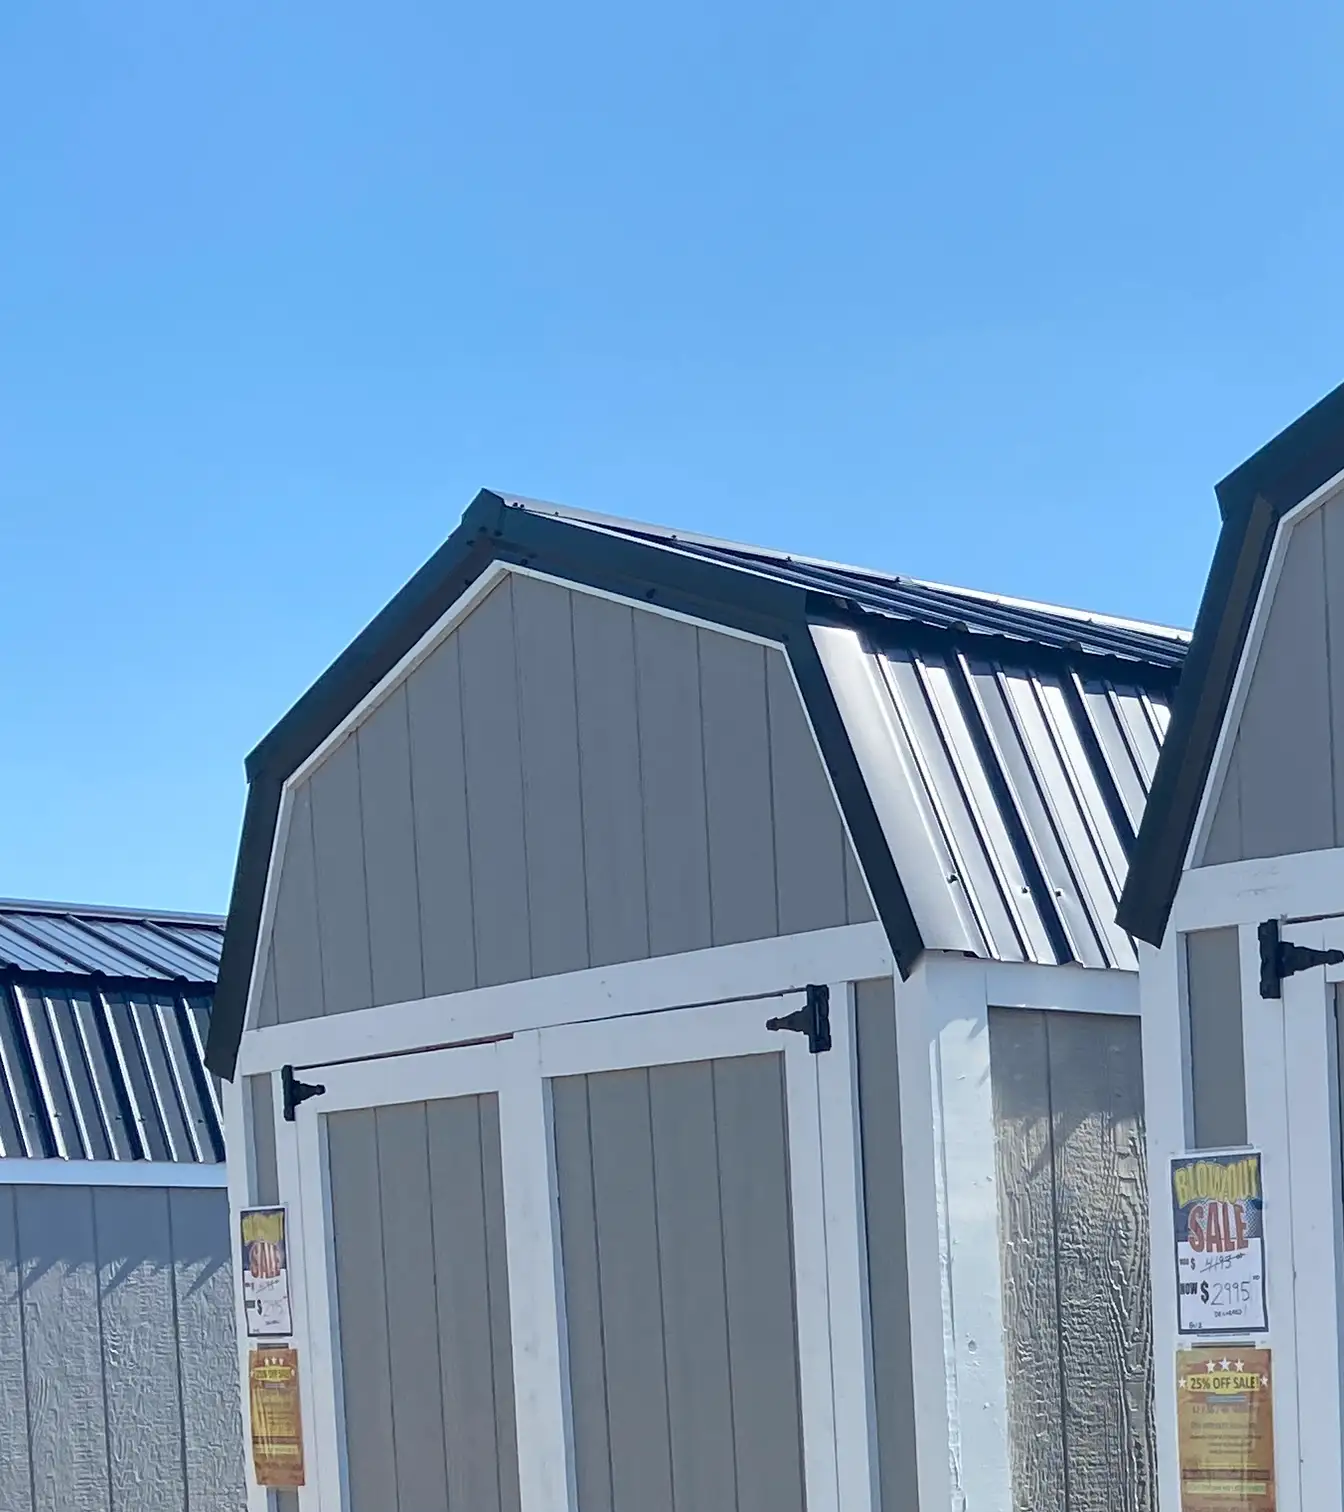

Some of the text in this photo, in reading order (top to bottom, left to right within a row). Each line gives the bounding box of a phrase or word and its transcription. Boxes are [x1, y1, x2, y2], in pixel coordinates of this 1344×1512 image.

[1175, 1159, 1258, 1209] BLOWOUT
[1188, 1201, 1249, 1253] SALE
[1180, 1282, 1198, 1295] NOW
[1201, 1280, 1209, 1304] $
[1211, 1281, 1250, 1305] 2995
[1191, 1377, 1210, 1389] 25%
[1213, 1377, 1231, 1389] OFF
